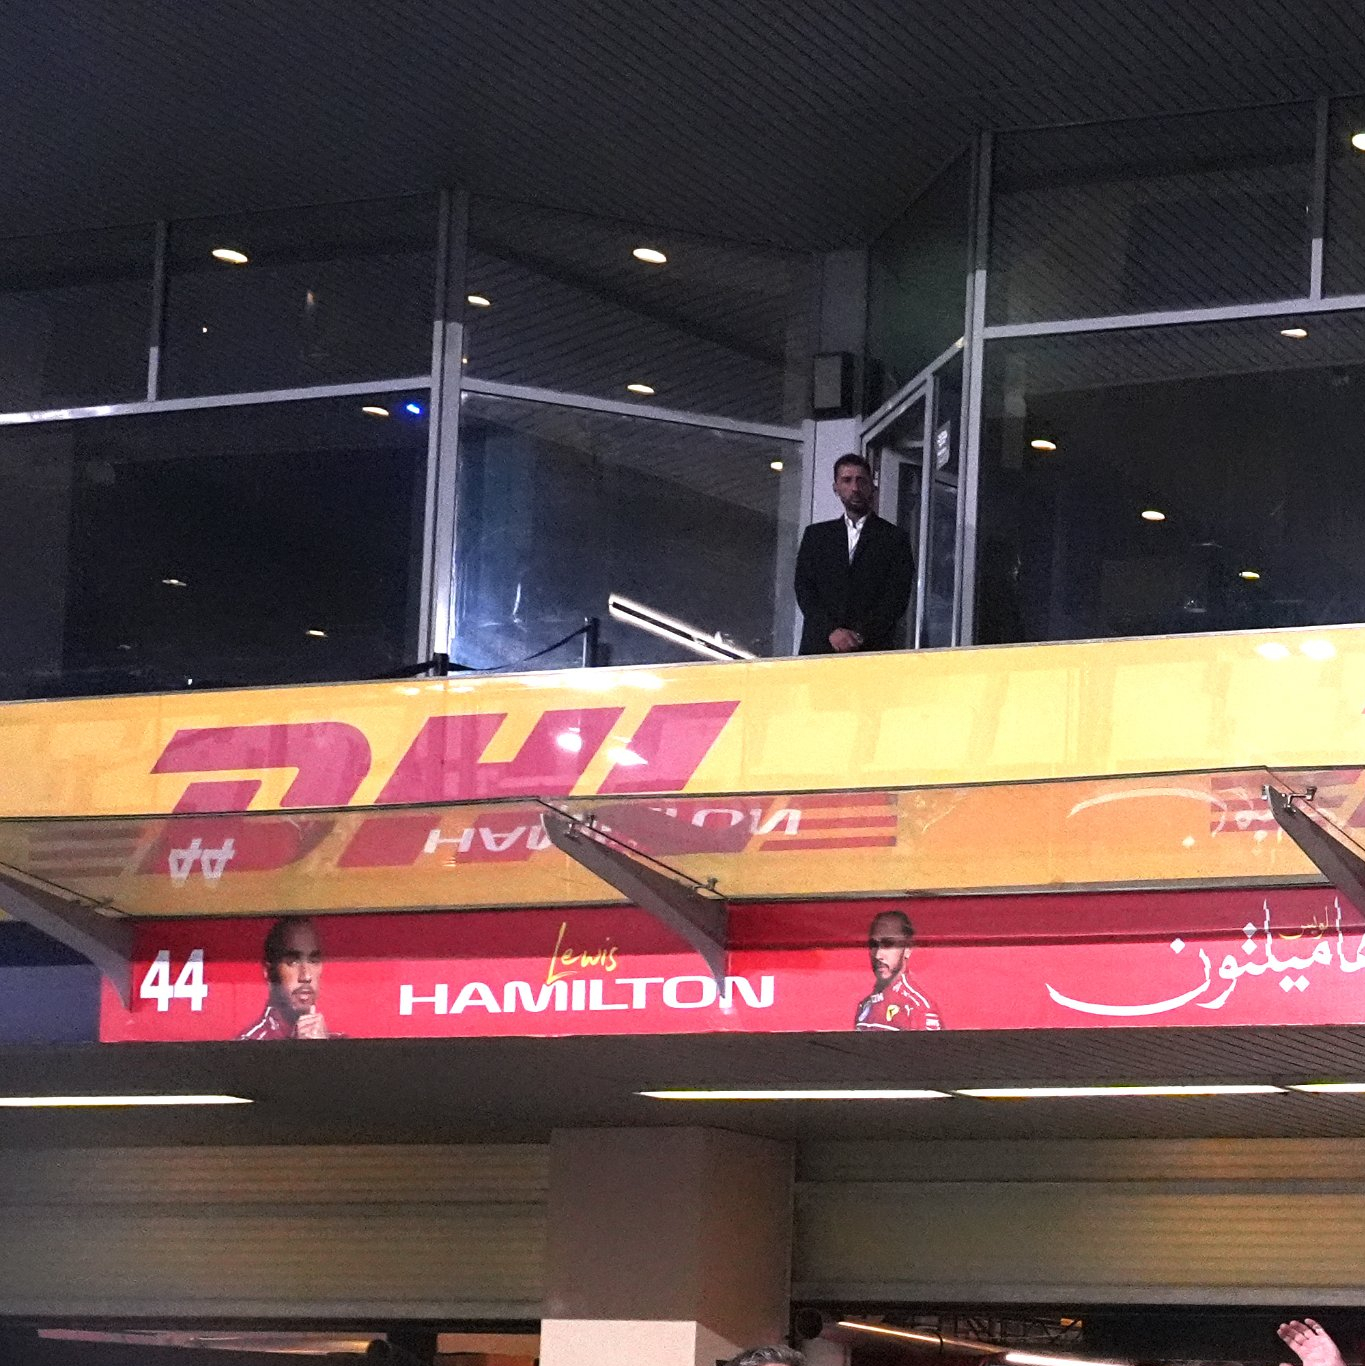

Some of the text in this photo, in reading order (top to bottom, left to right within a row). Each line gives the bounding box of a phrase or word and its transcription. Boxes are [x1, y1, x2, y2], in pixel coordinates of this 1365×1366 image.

[134, 701, 741, 875] DHL
[140, 948, 209, 1012] 44
[545, 921, 618, 987] Lewis
[400, 974, 776, 1017] HAMILTON
